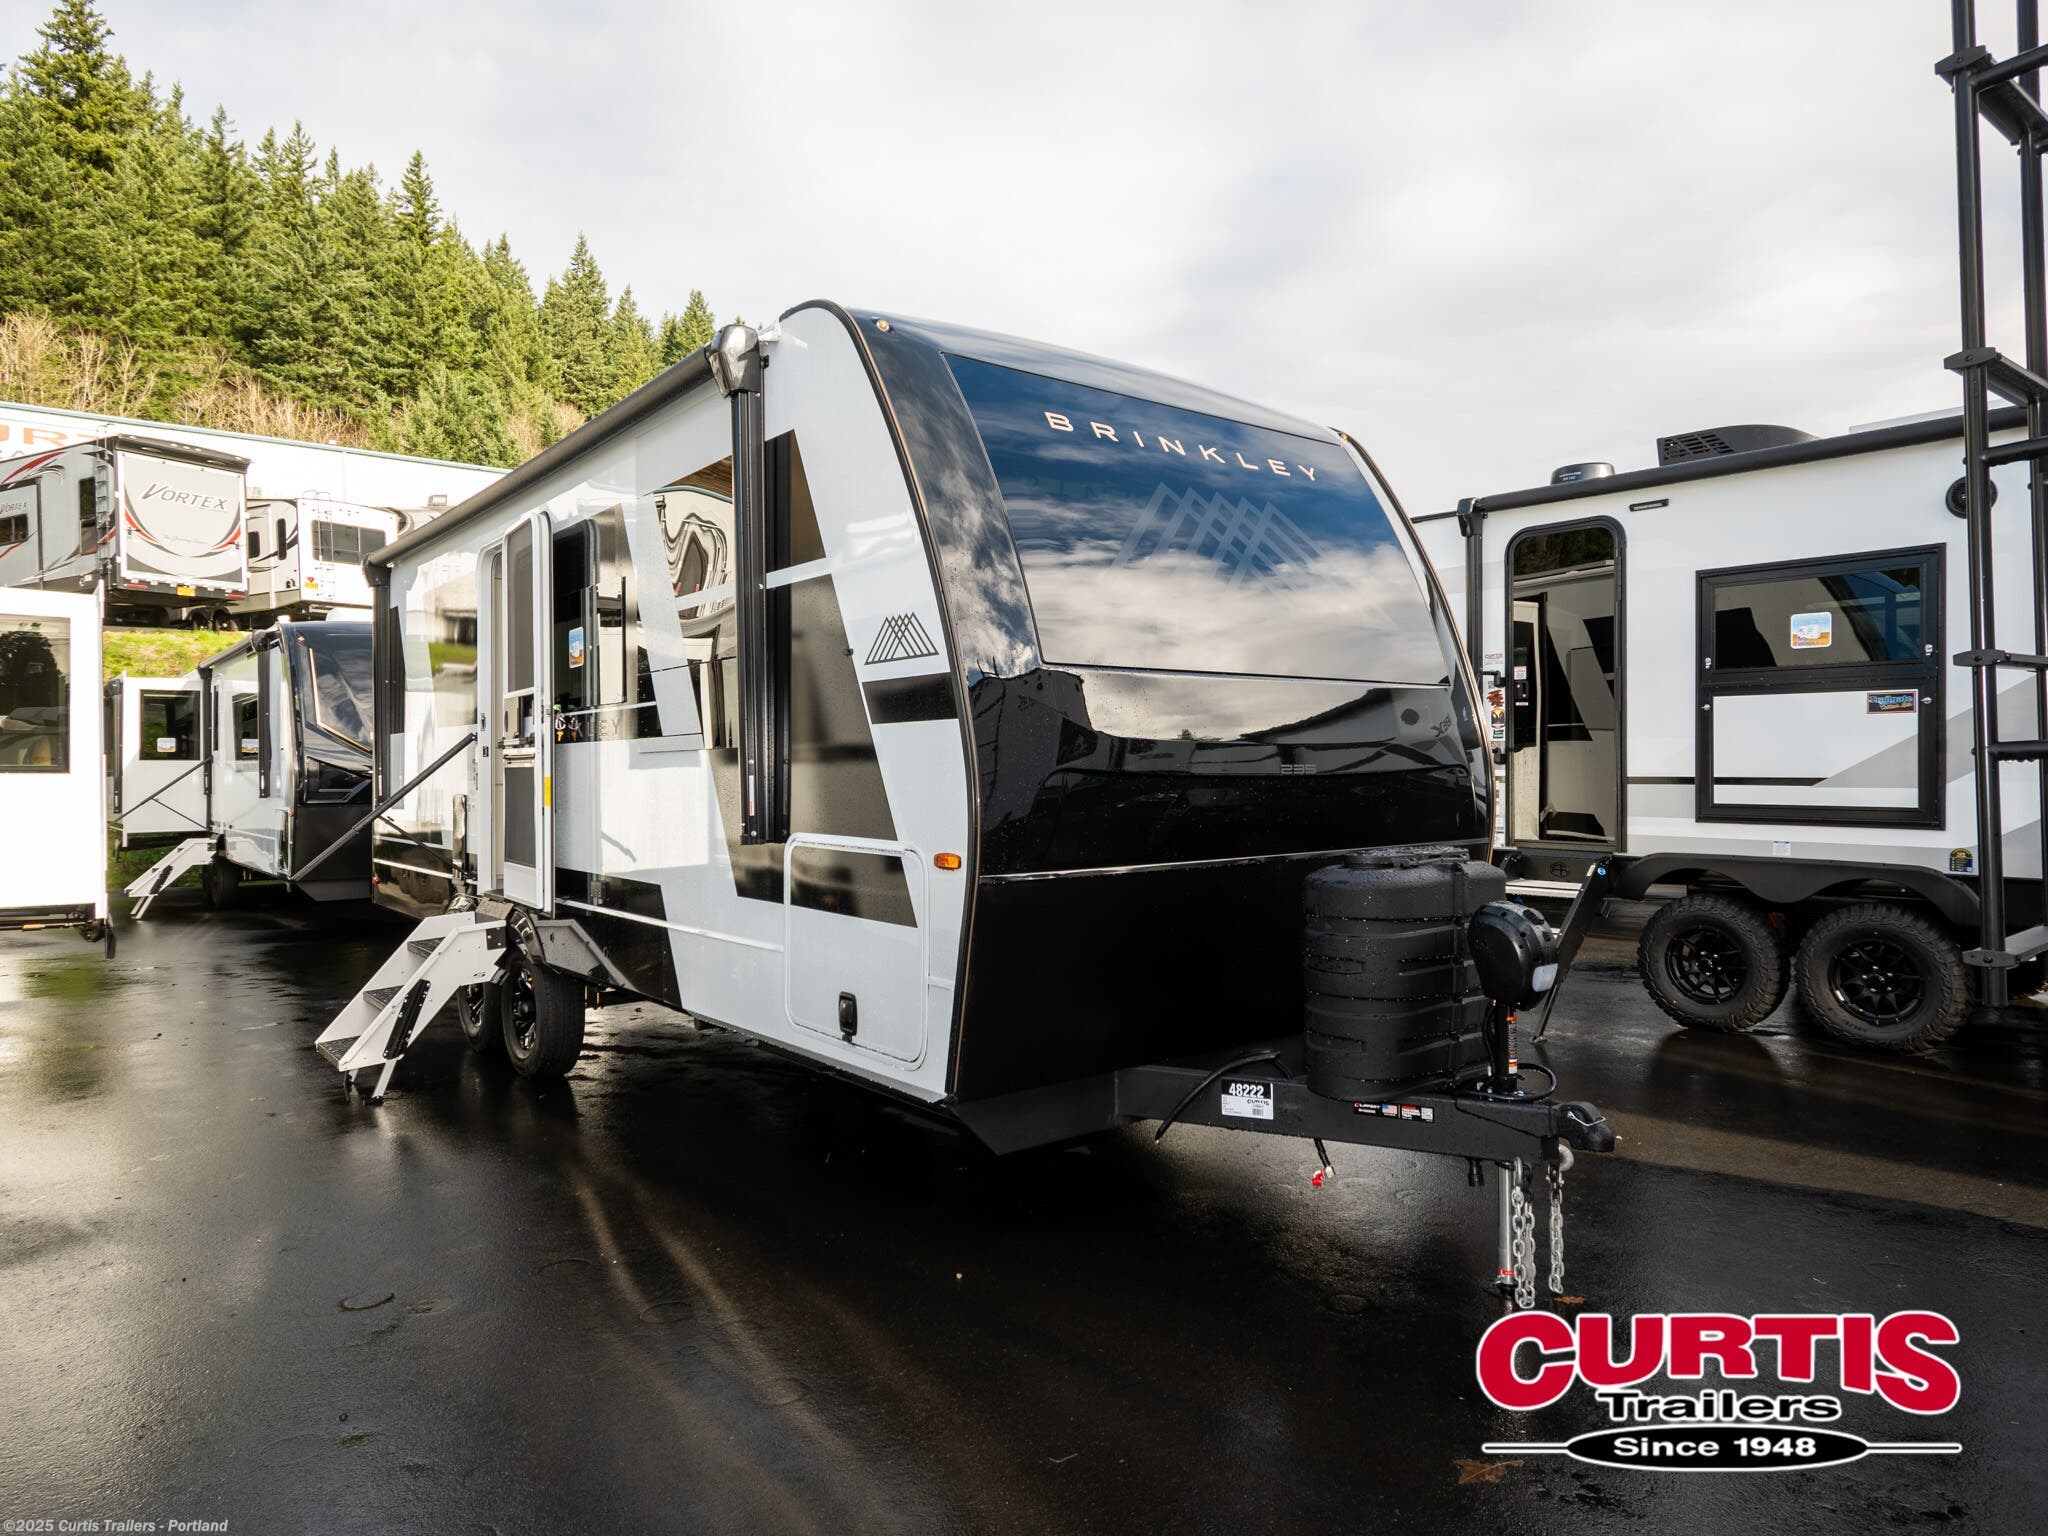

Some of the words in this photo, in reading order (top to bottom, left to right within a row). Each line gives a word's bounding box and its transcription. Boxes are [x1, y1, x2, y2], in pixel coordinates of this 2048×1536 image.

[1044, 411, 1316, 481] BRINKLEY
[141, 484, 228, 510] VORTEX
[1229, 1083, 1264, 1099] 48222
